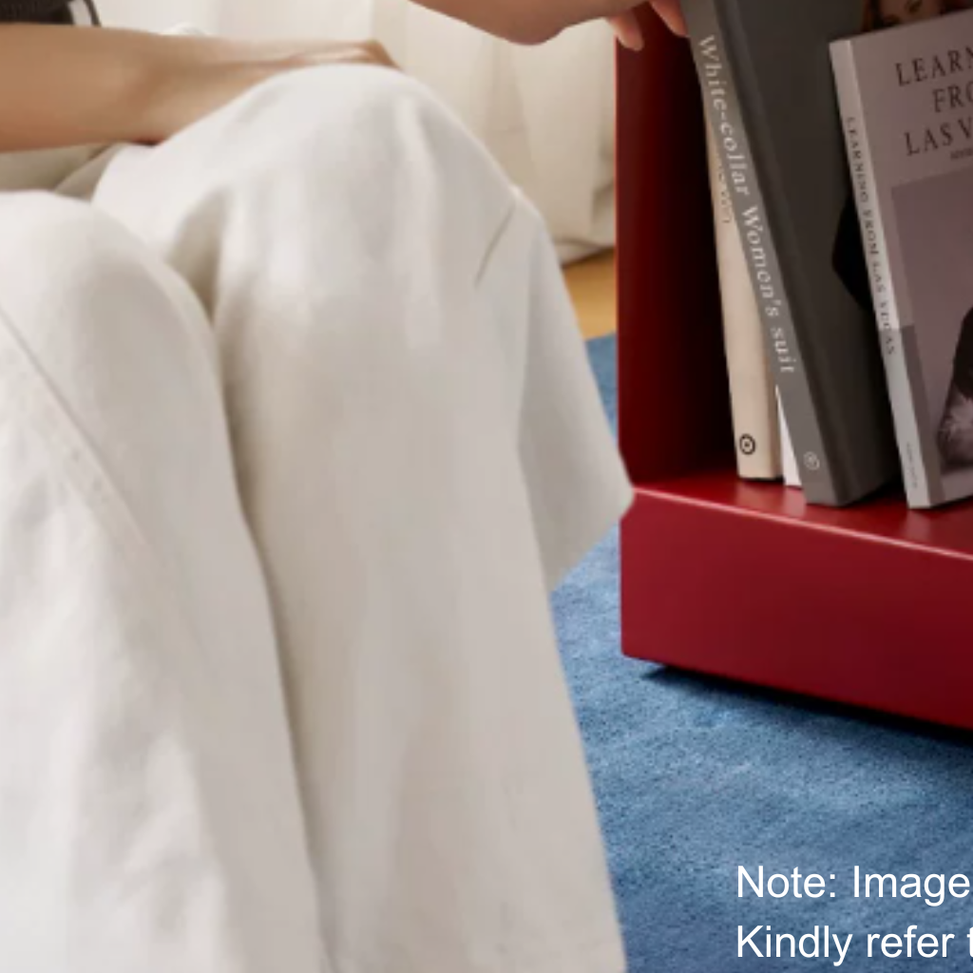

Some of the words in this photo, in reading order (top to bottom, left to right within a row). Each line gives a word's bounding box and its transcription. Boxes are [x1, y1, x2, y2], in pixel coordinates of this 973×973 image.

[698, 35, 750, 196] White-collar
[742, 205, 782, 317] Women's
[770, 327, 797, 373] suit
[904, 123, 954, 156] LAS
